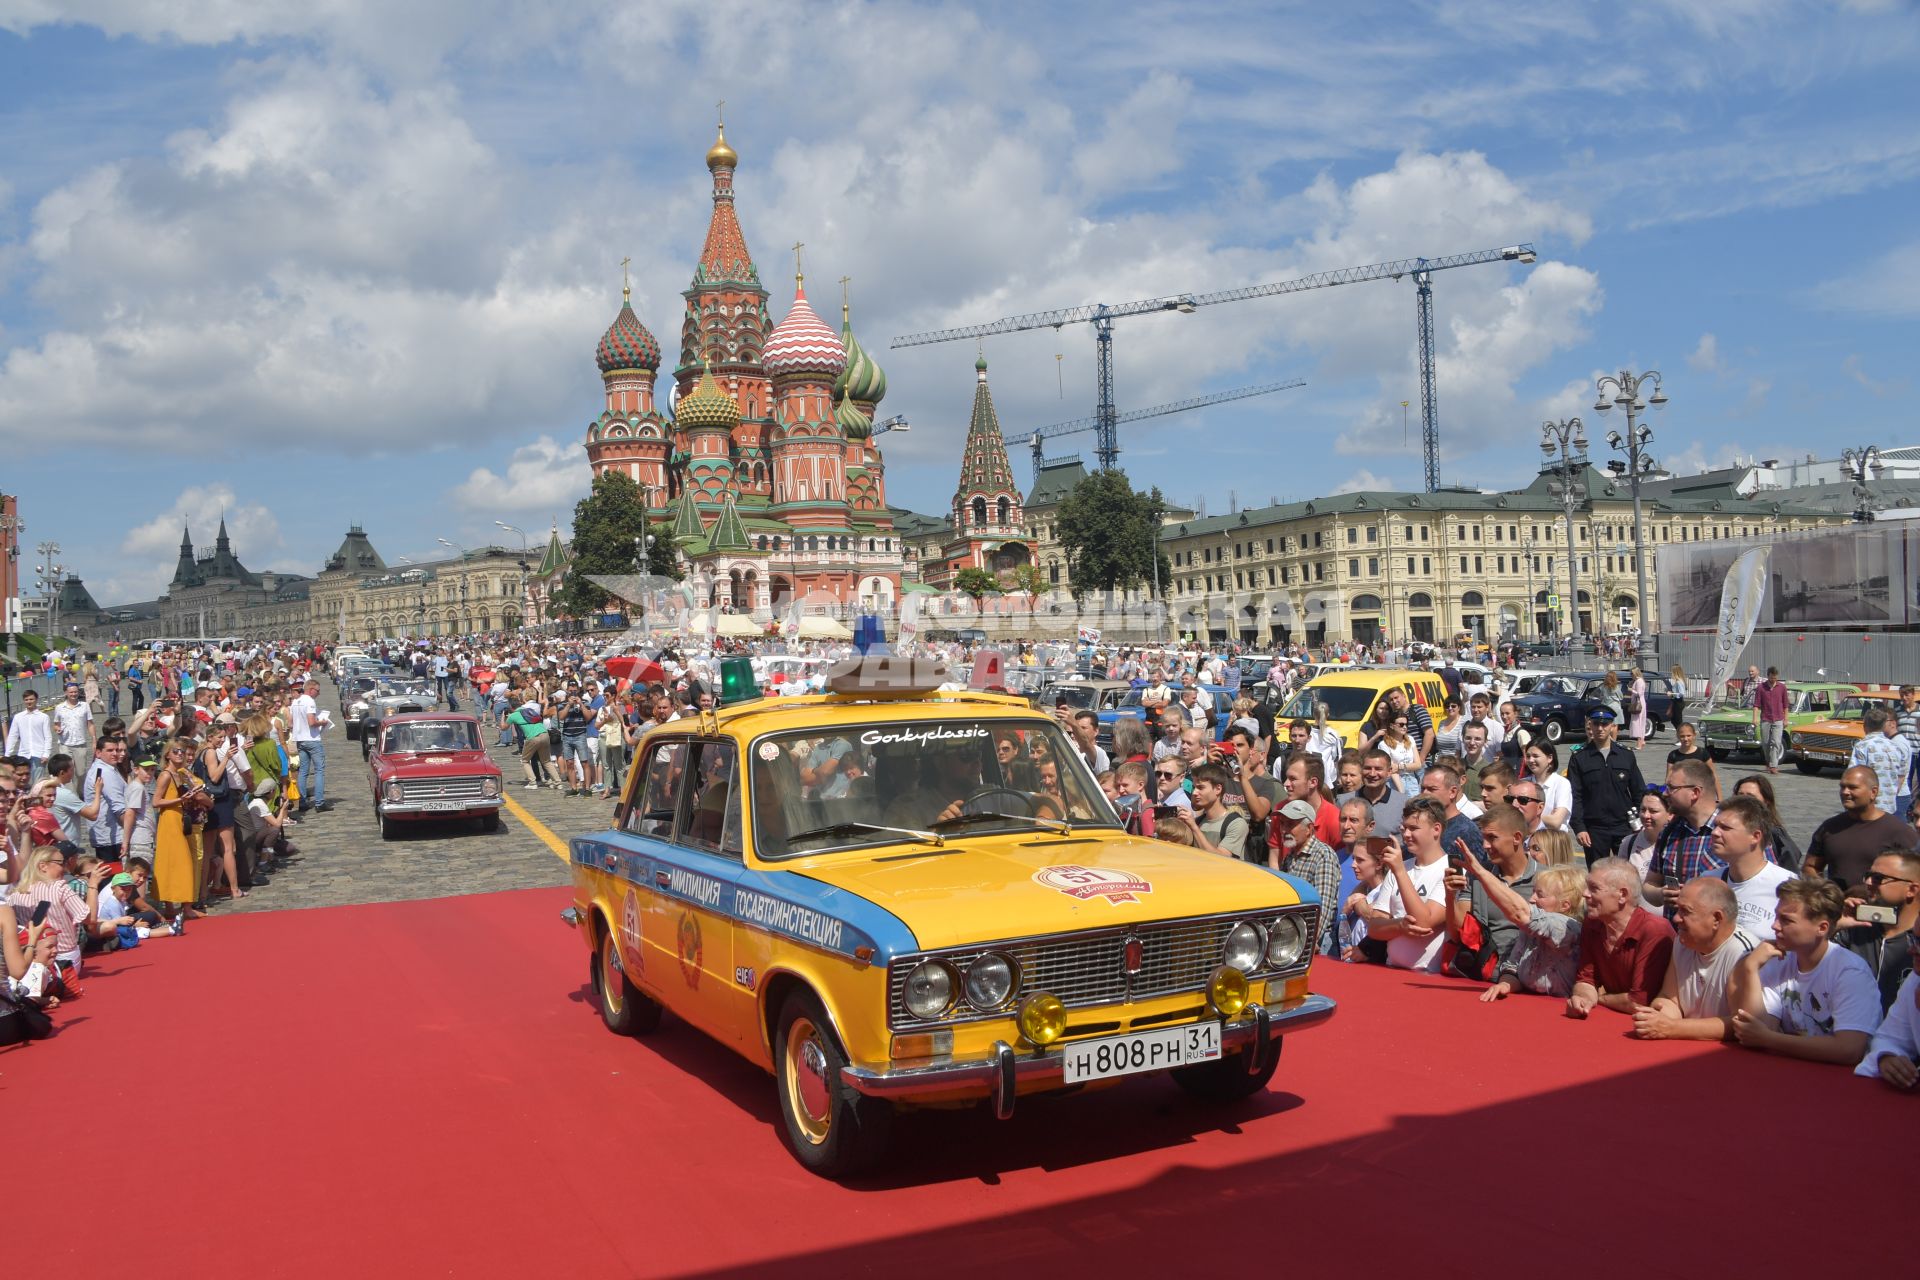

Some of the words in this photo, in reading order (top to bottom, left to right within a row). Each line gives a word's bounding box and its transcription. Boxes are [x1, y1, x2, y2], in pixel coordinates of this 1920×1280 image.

[860, 724, 989, 747] Gorkyclassic
[671, 868, 721, 906] МИЛИЦИЯ
[1060, 871, 1107, 883] 51
[627, 912, 635, 942] 51
[735, 889, 842, 949] ГОСАВТОИНСПЕКЦИЯ
[1076, 1039, 1180, 1077] Н808РН
[1188, 1026, 1211, 1050] 31
[1186, 1051, 1205, 1060] RUS
